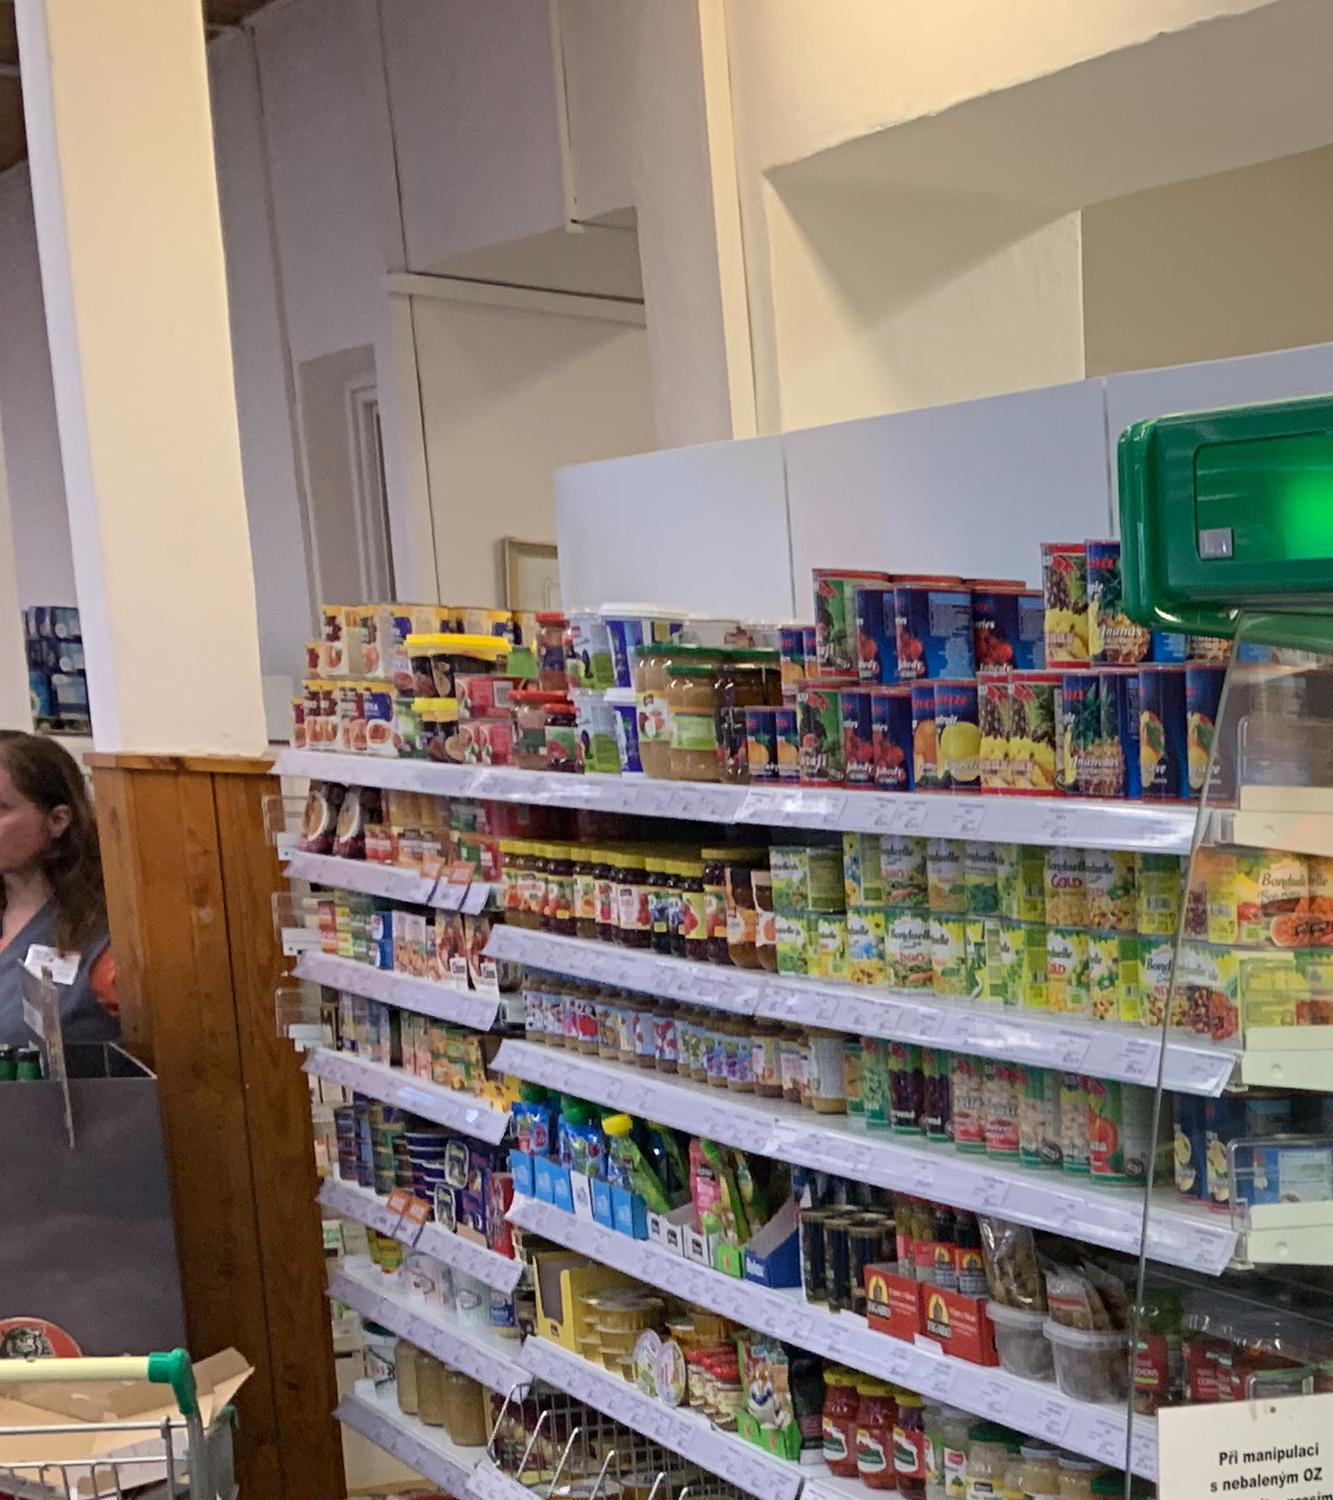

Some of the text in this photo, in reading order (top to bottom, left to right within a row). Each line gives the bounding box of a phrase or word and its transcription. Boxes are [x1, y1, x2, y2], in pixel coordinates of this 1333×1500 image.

[1218, 1442, 1320, 1466] Při manipulaci
[1210, 1467, 1323, 1493] s nebaleným OZ
